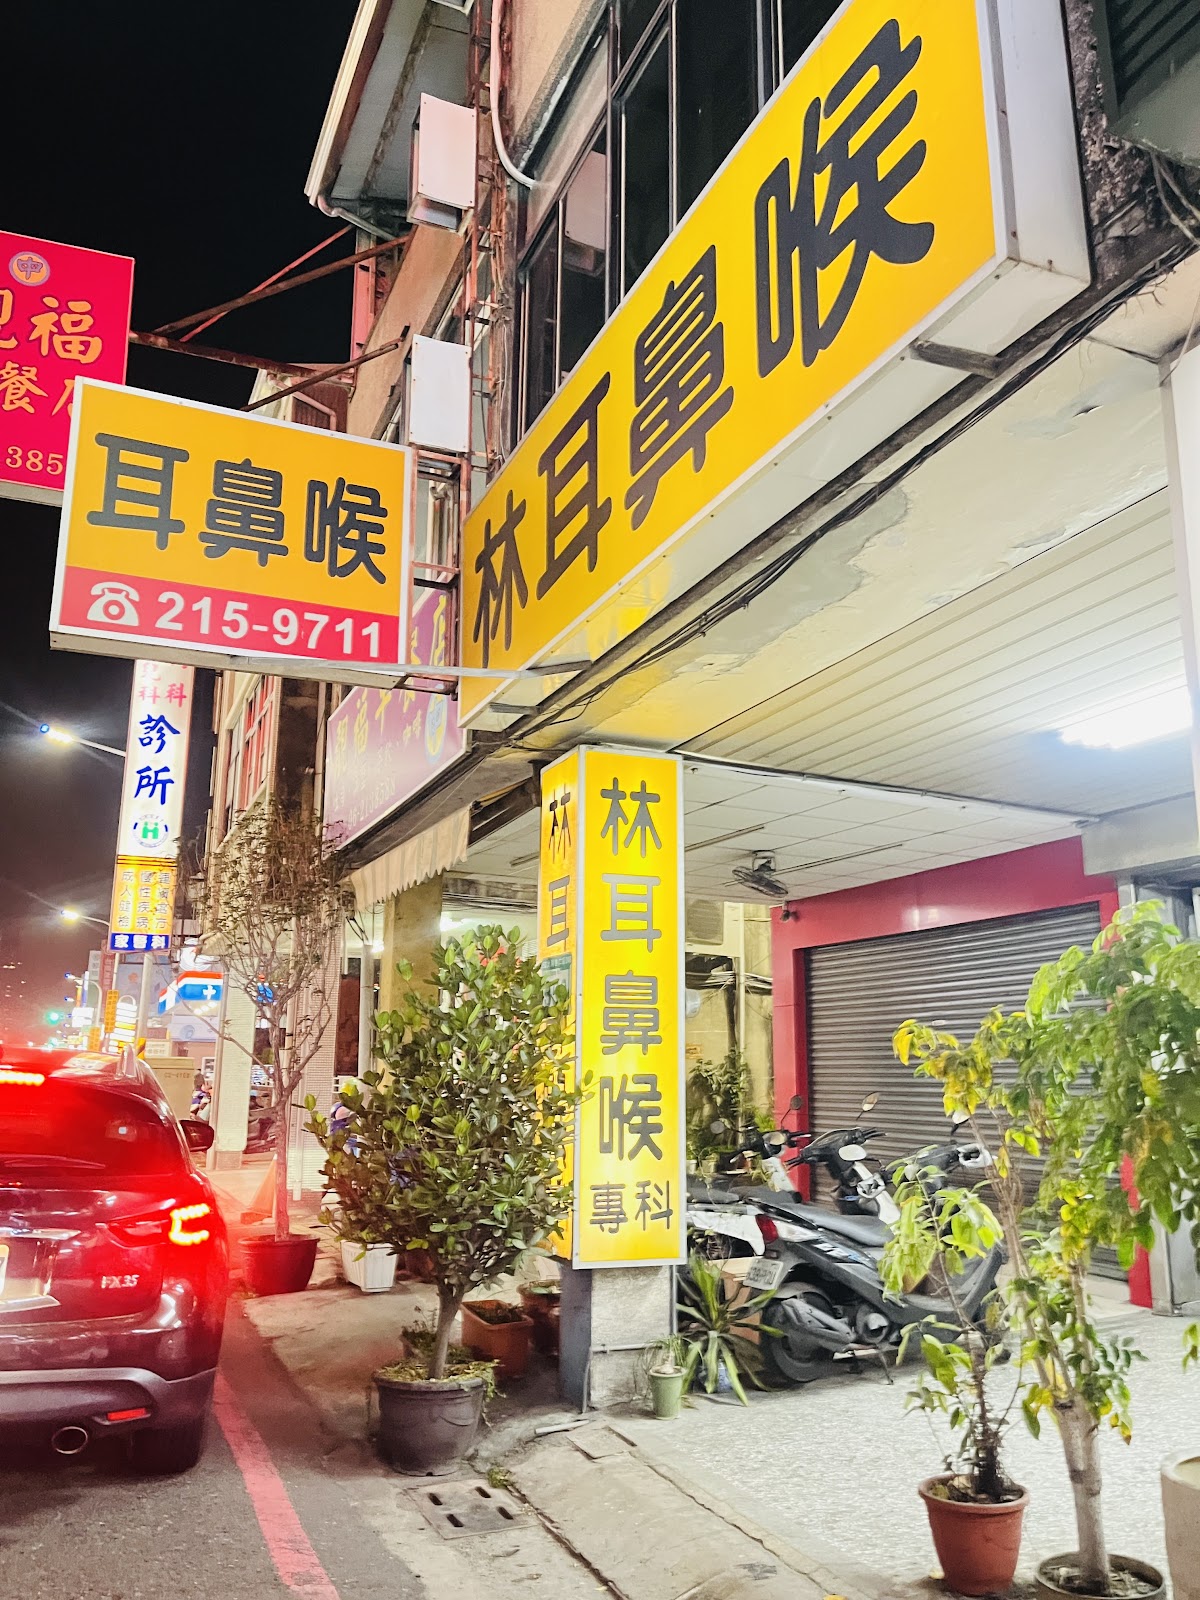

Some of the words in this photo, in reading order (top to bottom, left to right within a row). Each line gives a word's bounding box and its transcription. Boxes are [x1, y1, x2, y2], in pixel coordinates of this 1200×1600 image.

[473, 18, 935, 668] 林耳鼻喉
[86, 432, 389, 585] 耳鼻喉
[156, 591, 380, 659] 215-9711
[134, 714, 181, 807] 診所
[599, 776, 663, 1161] 林耳鼻喉
[588, 1179, 674, 1233] 專科
